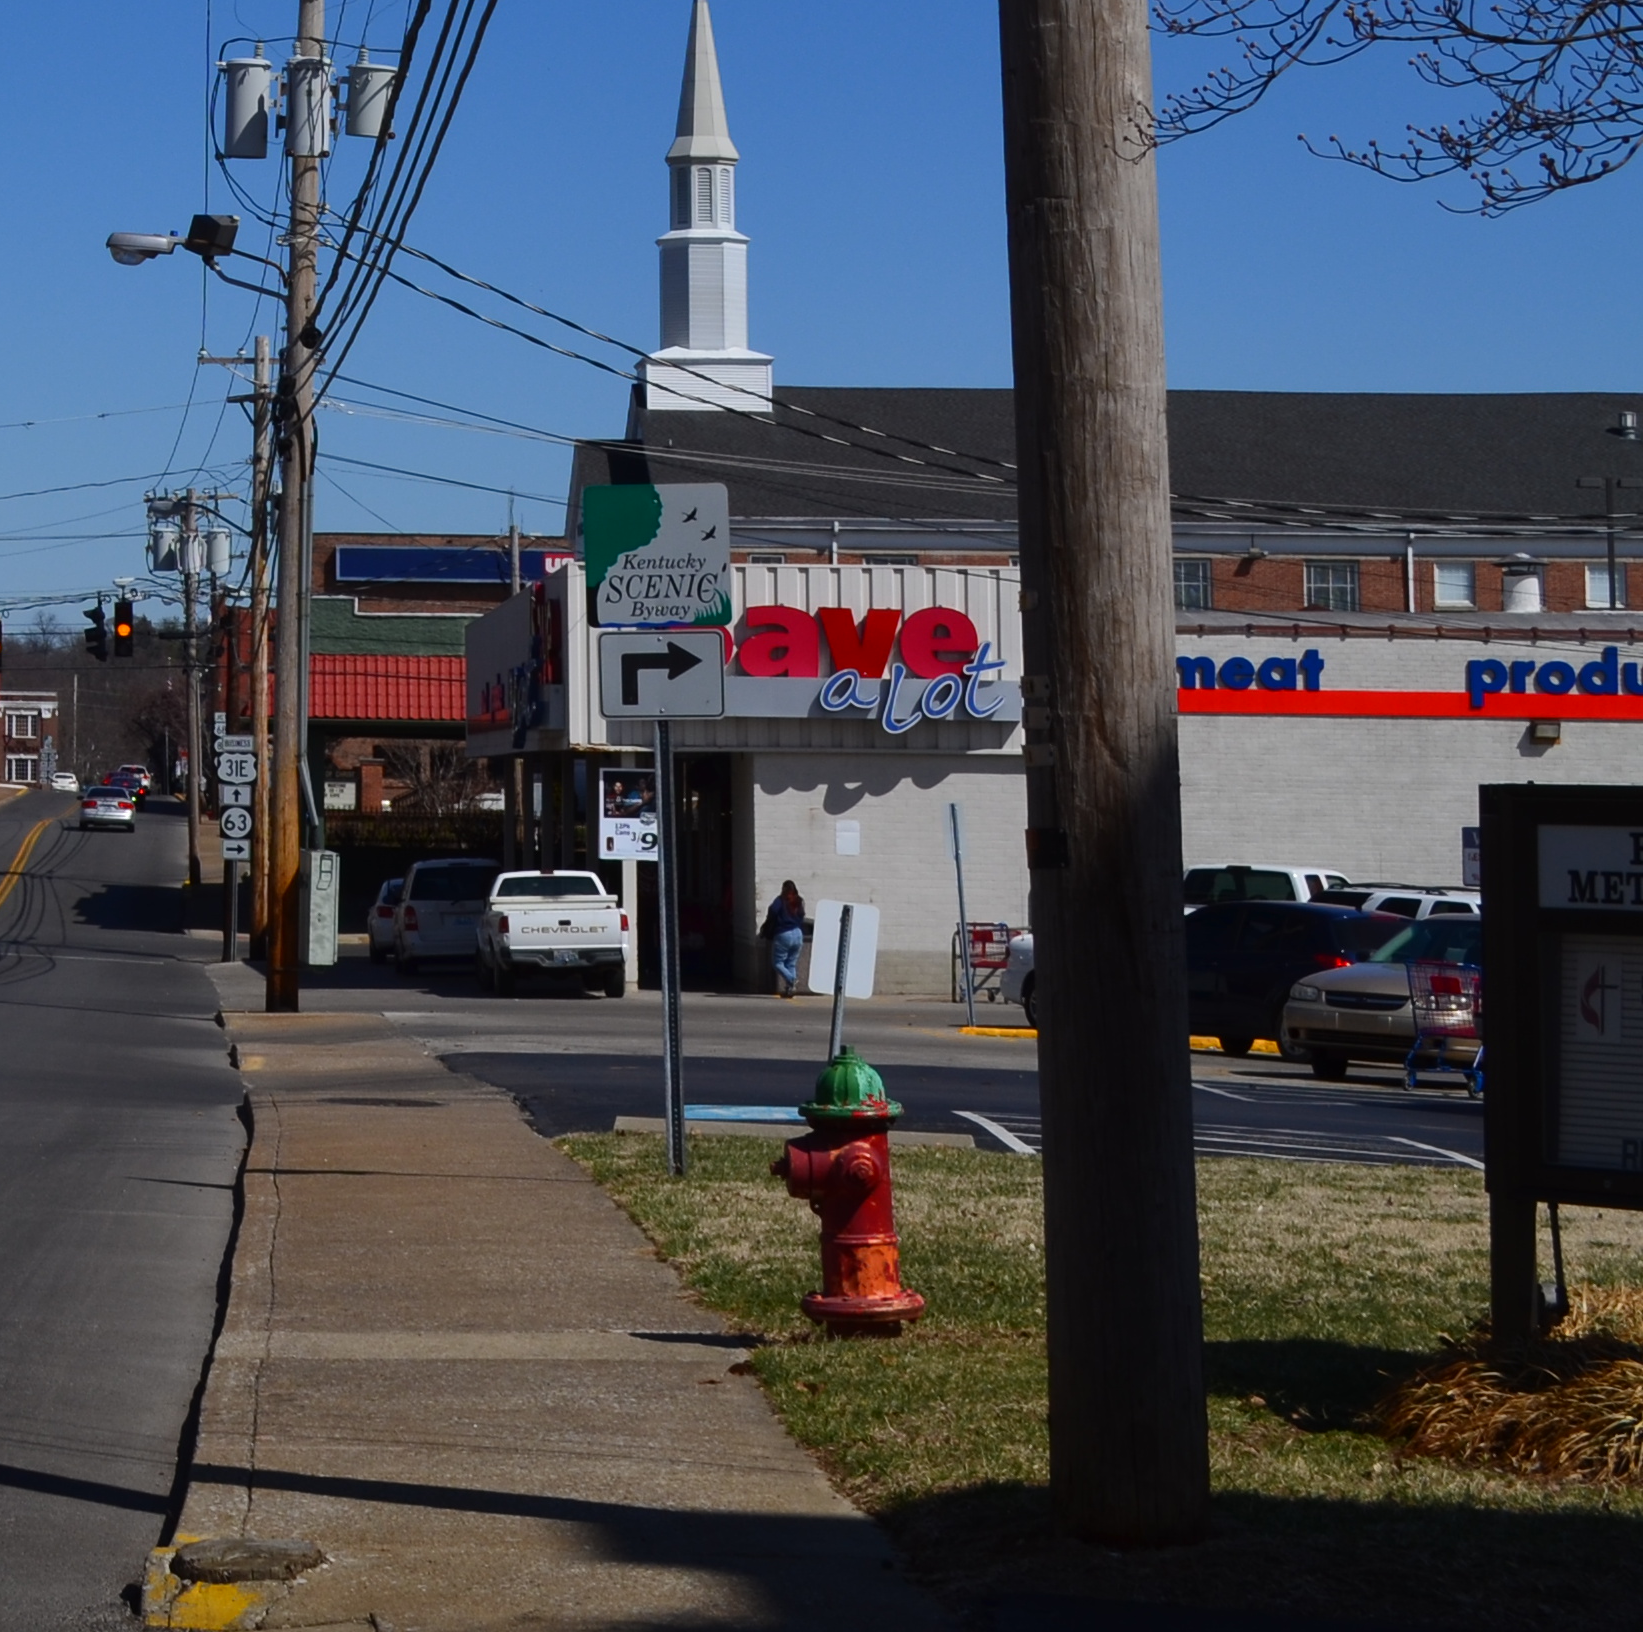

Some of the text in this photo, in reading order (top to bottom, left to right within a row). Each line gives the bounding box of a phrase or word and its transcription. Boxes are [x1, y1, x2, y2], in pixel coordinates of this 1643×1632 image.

[621, 552, 707, 573] Kentucky
[605, 572, 719, 604] SCENIC
[630, 601, 691, 621] Byway
[675, 605, 980, 680] ave
[224, 739, 251, 748] BUSINESS
[225, 758, 249, 778] 31E
[223, 813, 247, 832] 63
[521, 926, 608, 934] CHEVROLET
